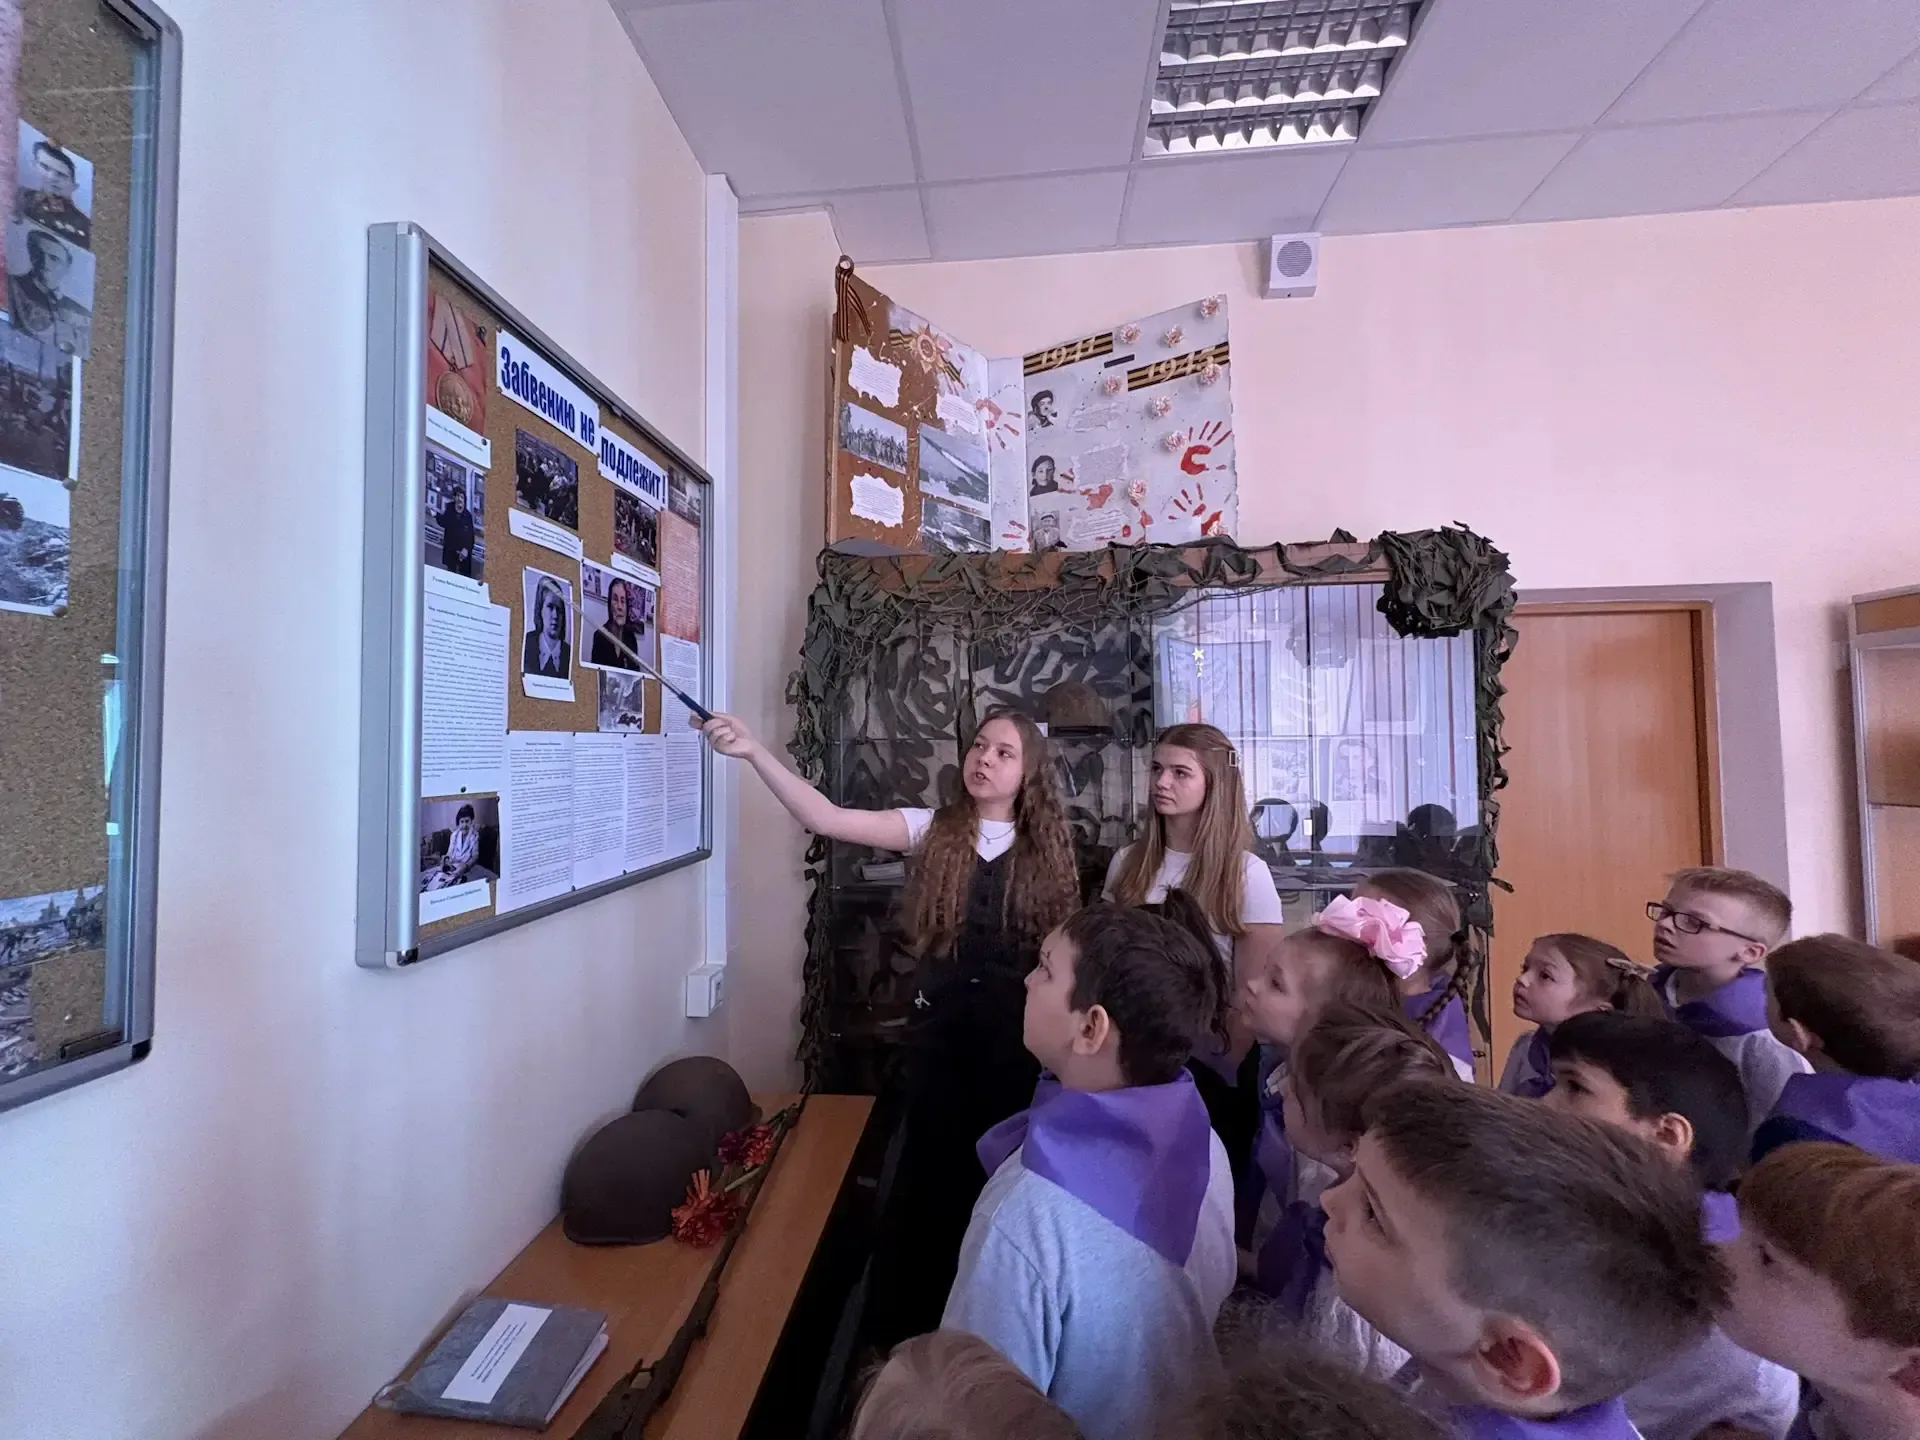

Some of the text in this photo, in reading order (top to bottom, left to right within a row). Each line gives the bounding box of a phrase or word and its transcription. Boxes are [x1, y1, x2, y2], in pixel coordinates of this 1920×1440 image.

[1040, 336, 1096, 369] 1941
[501, 346, 576, 434] Забвению
[580, 411, 596, 448] не
